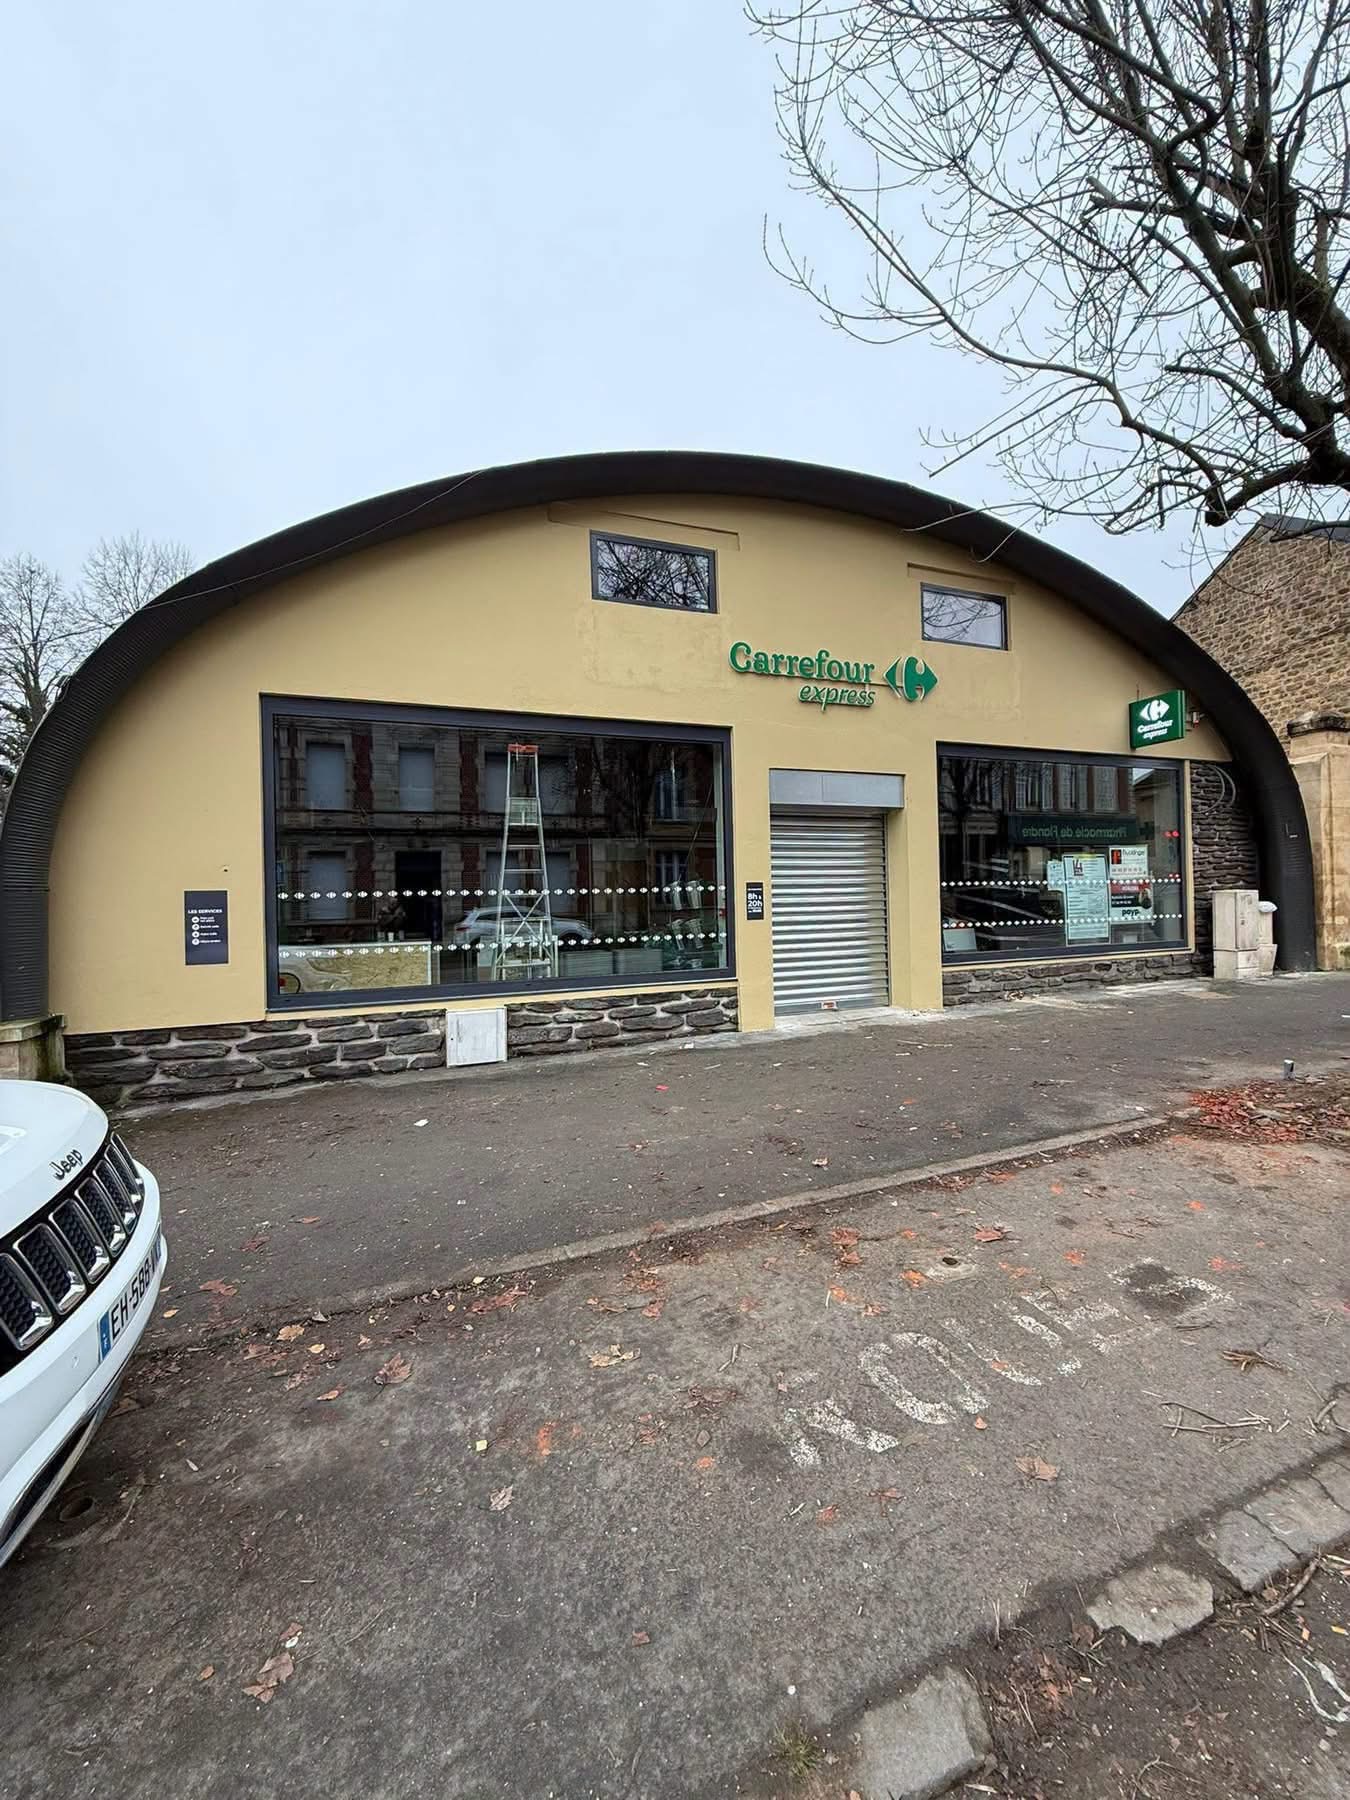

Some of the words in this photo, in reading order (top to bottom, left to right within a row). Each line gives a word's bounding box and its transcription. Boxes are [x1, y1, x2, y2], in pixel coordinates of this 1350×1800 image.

[729, 641, 875, 684] Carrefour
[799, 684, 876, 713] express
[1137, 719, 1174, 734] Carrefour
[49, 1149, 83, 1180] Jeep
